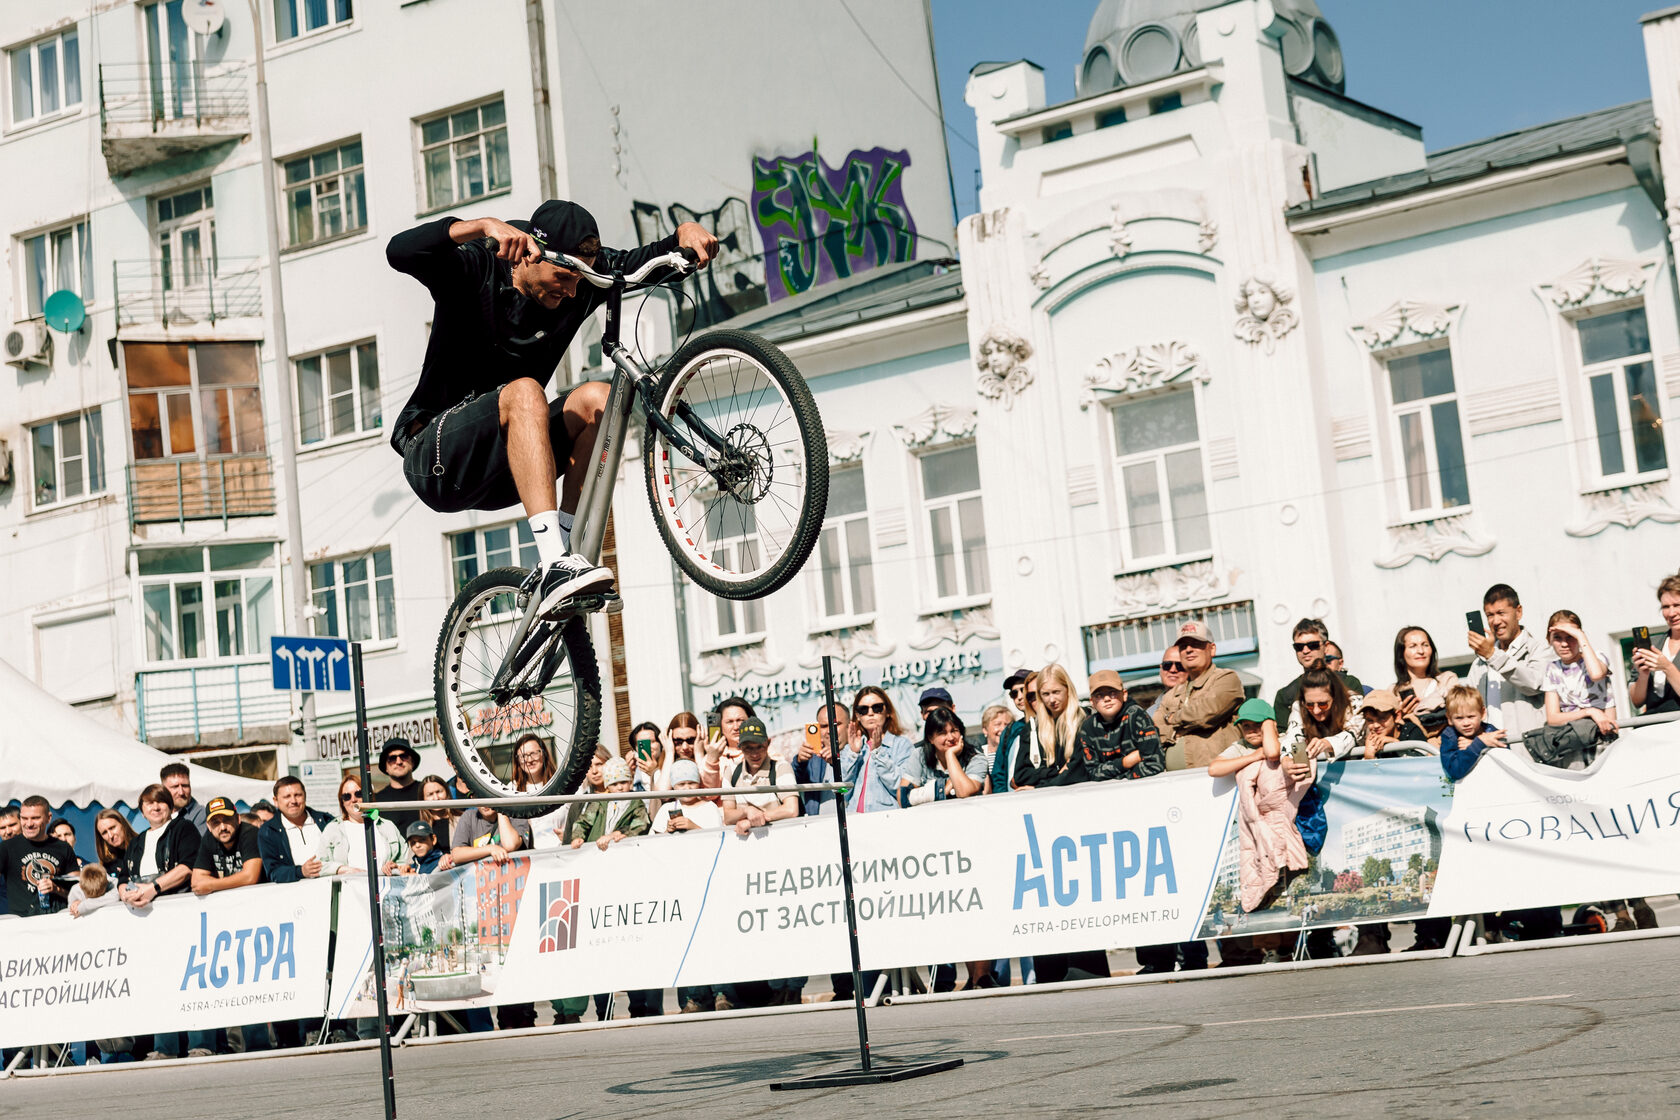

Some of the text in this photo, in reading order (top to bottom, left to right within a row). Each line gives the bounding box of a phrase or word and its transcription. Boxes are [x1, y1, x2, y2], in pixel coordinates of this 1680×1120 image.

[880, 649, 982, 686] ДВОРИК
[746, 850, 973, 897] НЕДВИЖИМОСТЬ
[1012, 813, 1178, 911] АСТРА
[590, 899, 683, 929] VENEZIA
[737, 908, 769, 934] ОТ
[1012, 908, 1180, 936] ASTRA-DEVELOPMENT.RU
[0, 947, 128, 982] ВИЖИМОСТЬ
[180, 911, 296, 991] АСТРА
[180, 991, 297, 1012] ASTRA-DEVELOPMENT.RU
